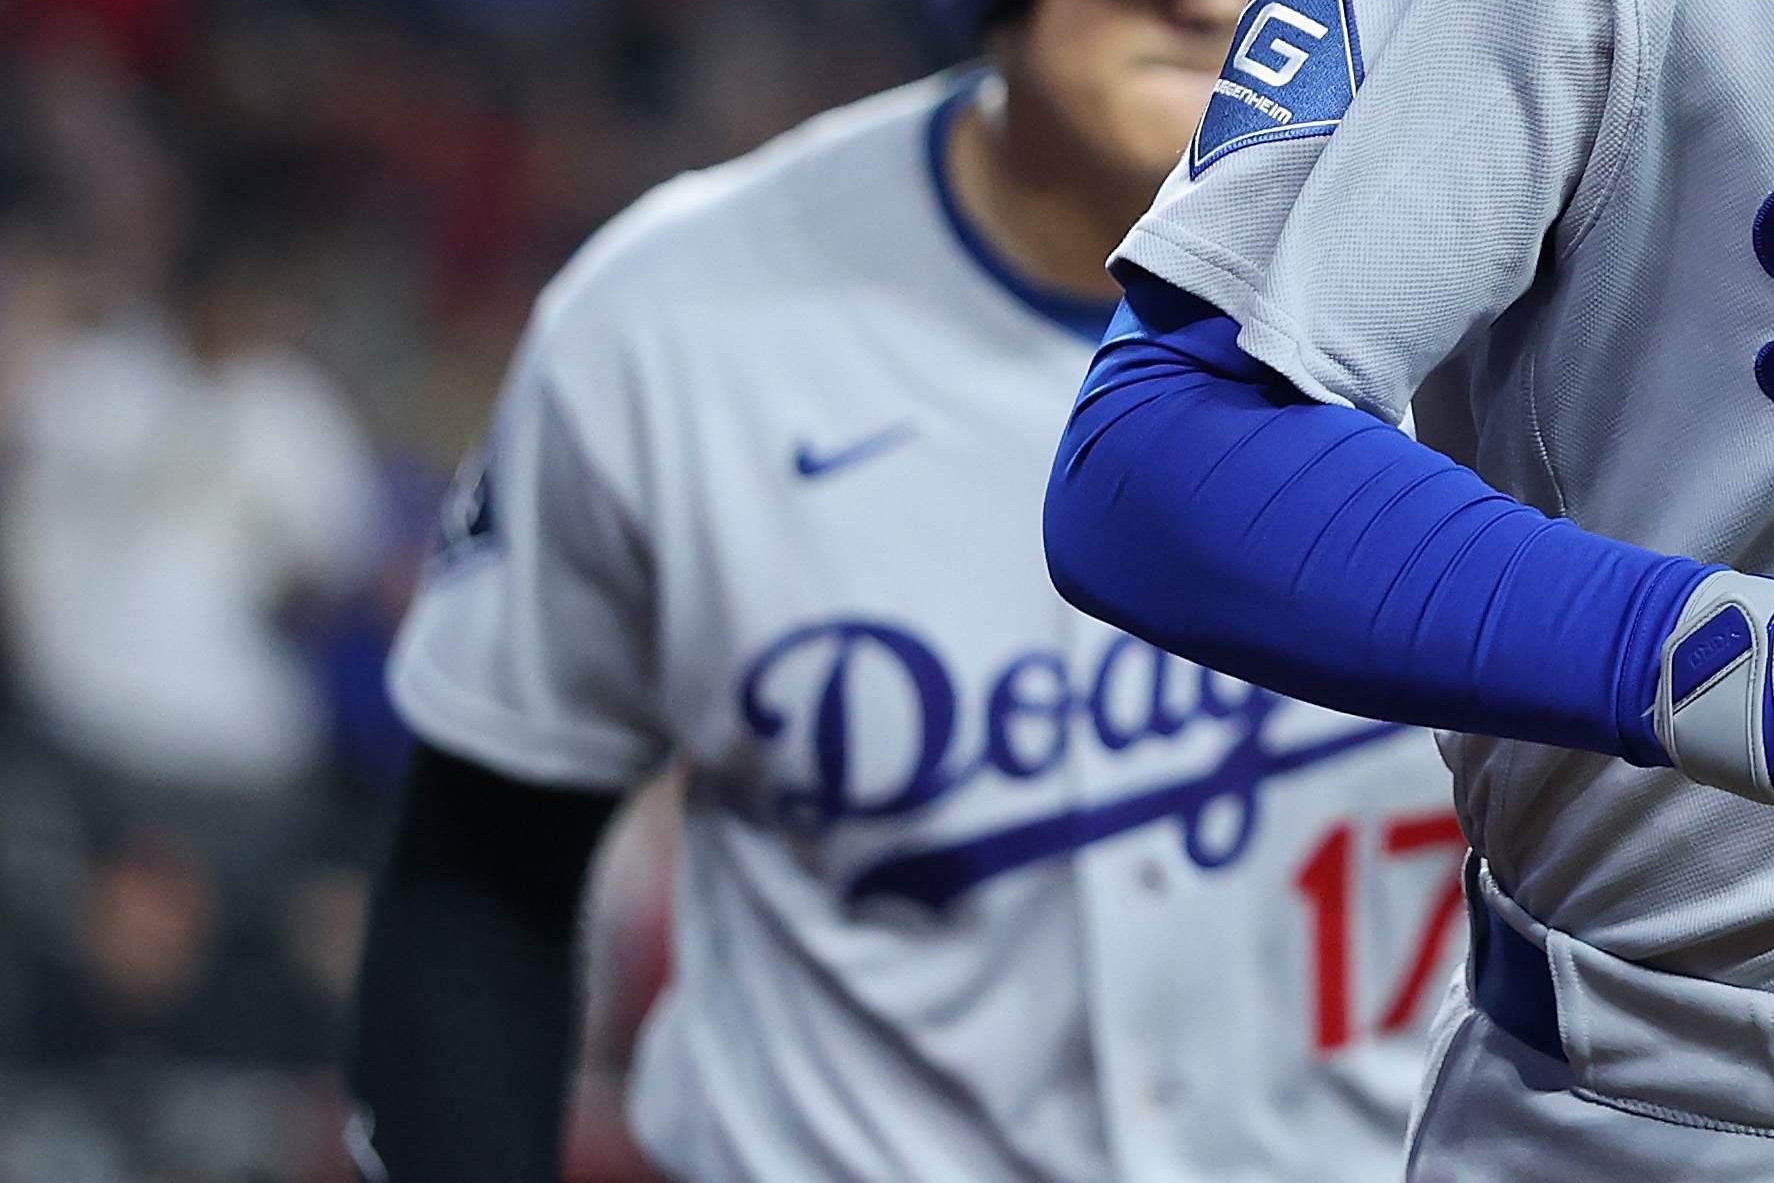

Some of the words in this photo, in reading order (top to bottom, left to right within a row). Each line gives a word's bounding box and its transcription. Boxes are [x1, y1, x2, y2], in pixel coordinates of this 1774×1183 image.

[1233, 1, 1329, 87] G
[738, 616, 1288, 871] Dodg
[1291, 808, 1468, 1055] 17
